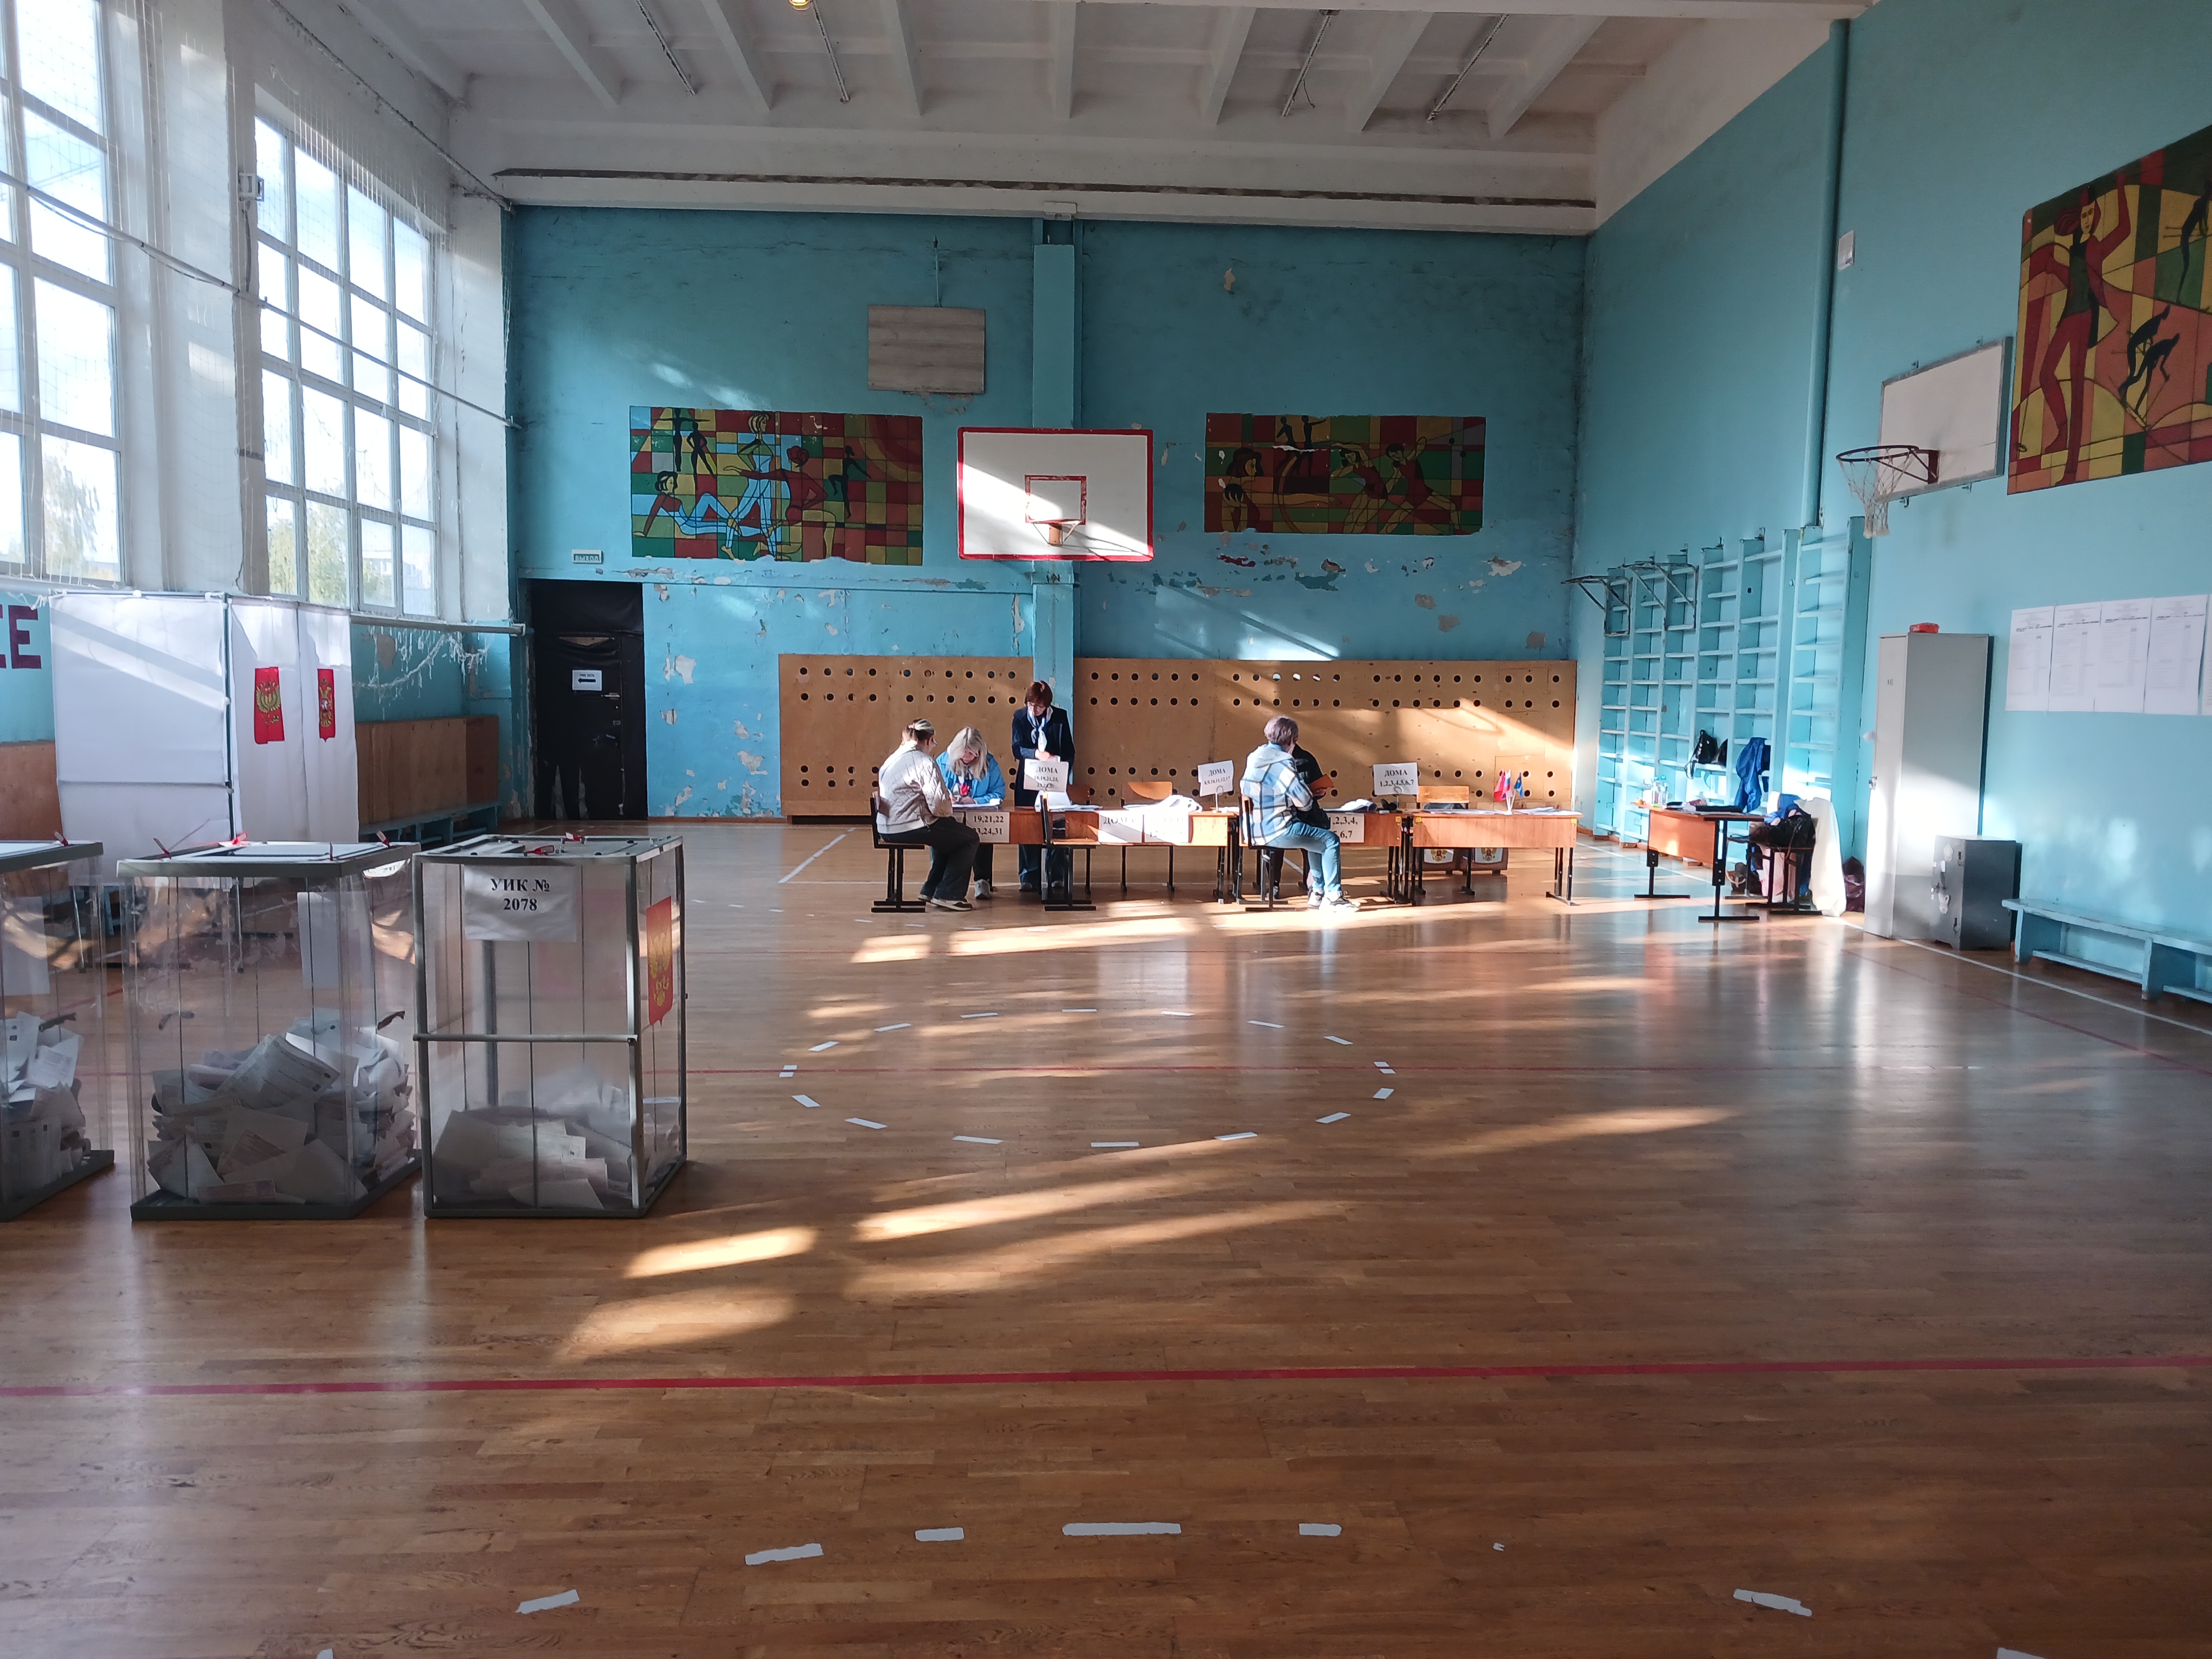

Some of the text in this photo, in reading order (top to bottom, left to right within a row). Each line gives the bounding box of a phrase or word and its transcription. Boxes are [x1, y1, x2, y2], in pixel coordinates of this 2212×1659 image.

[0, 604, 42, 669] Е
[1036, 766, 1058, 774] ДОМА
[1208, 768, 1226, 777] ДОМА
[1384, 769, 1407, 777] ДОМА
[490, 878, 550, 892] УИК №
[503, 898, 537, 911] 2078
